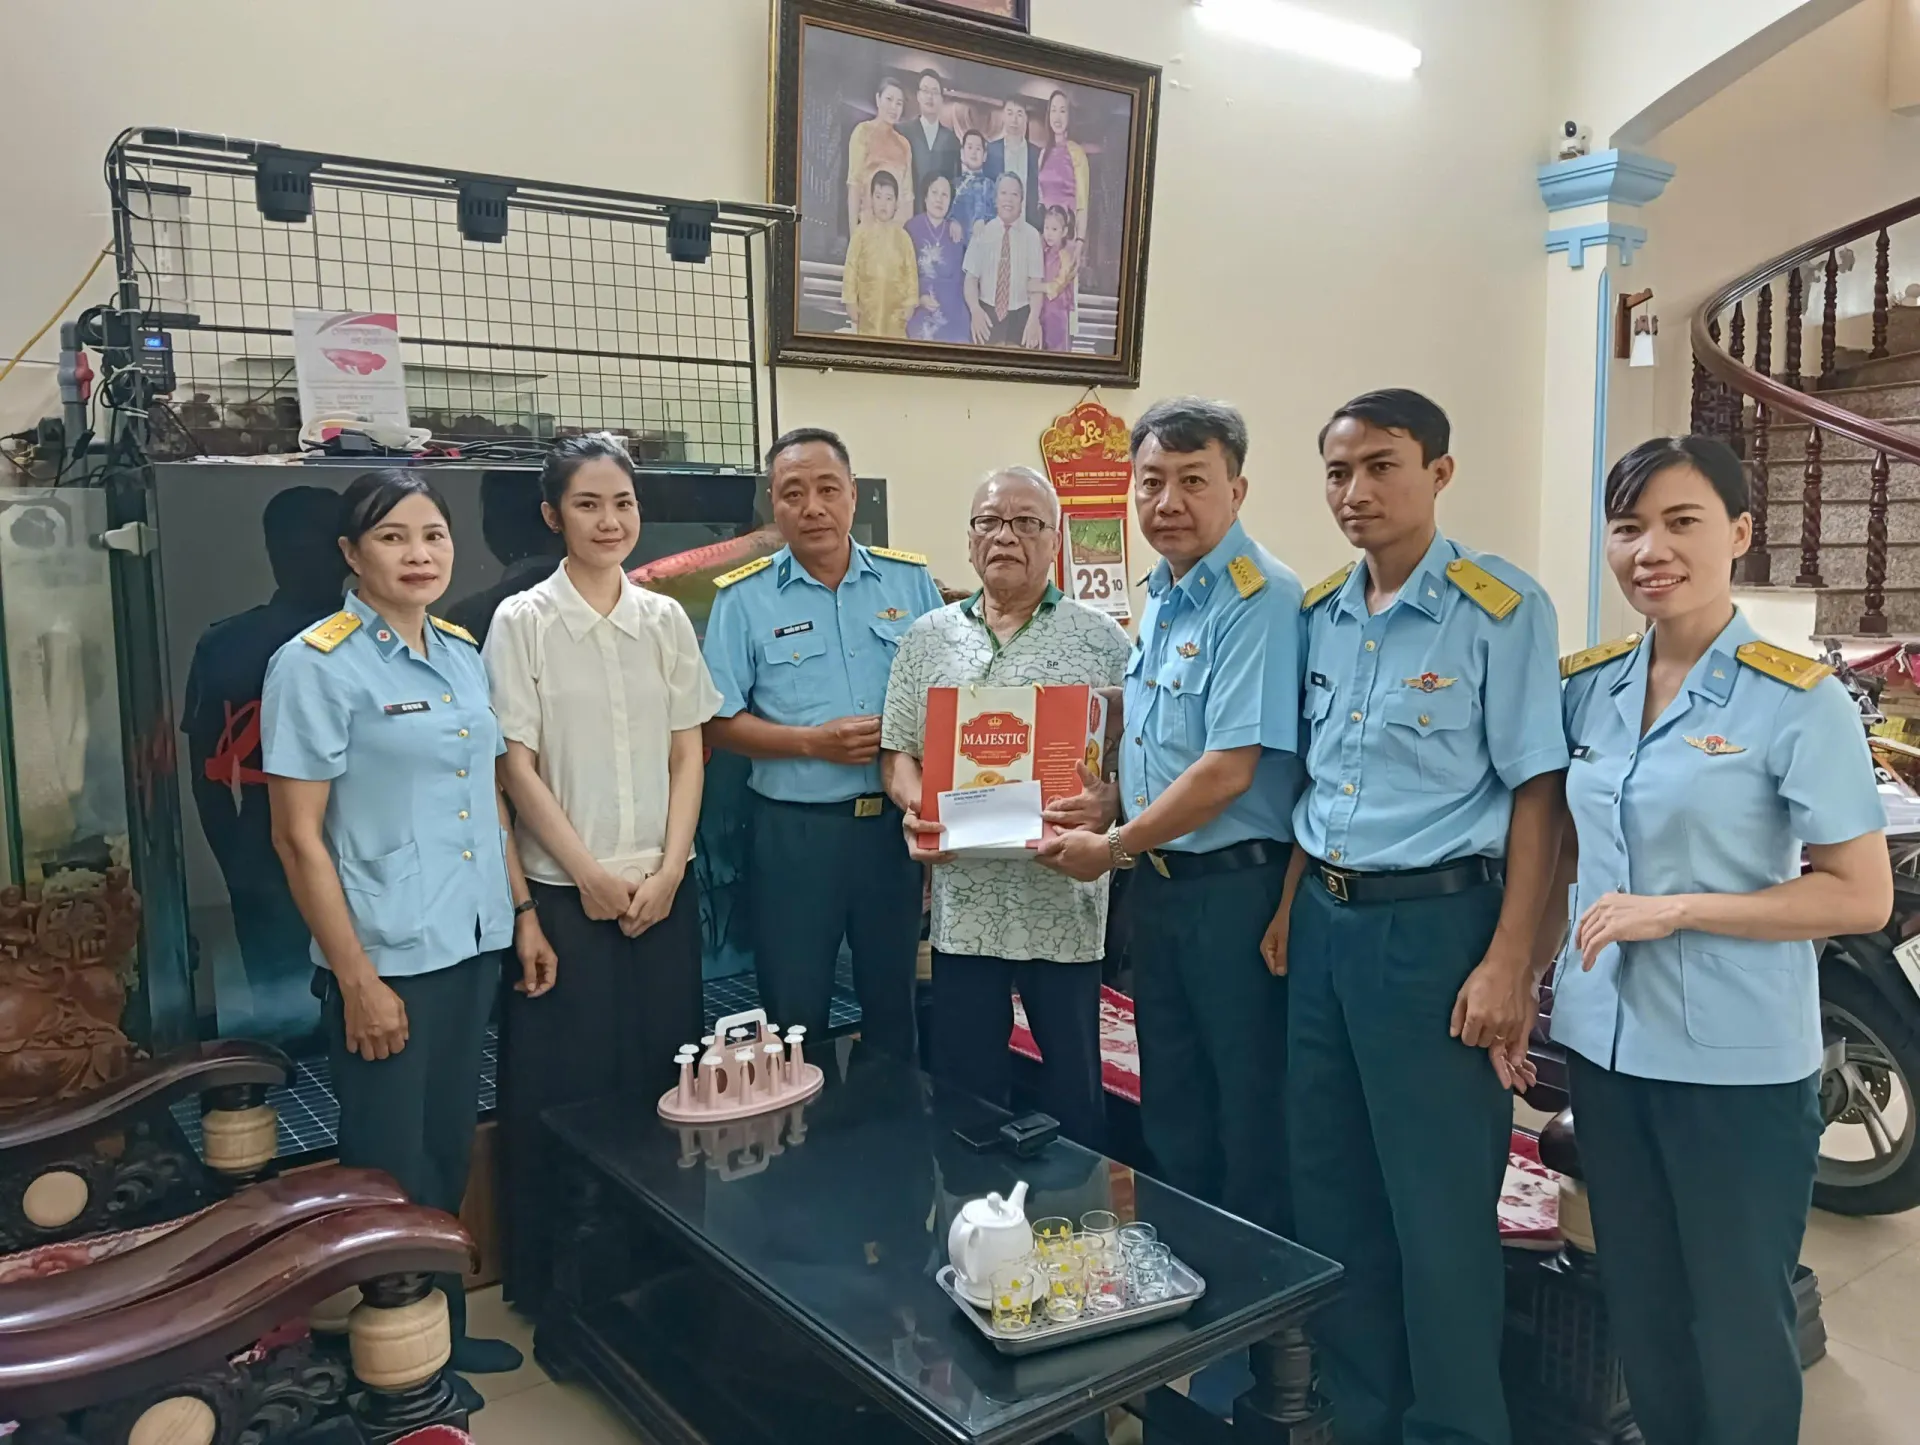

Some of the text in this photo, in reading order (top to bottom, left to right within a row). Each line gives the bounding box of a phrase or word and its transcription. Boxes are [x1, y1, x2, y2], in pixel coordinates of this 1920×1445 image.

[1077, 568, 1123, 599] 23 10
[963, 733, 1025, 745] MAJESTIC
